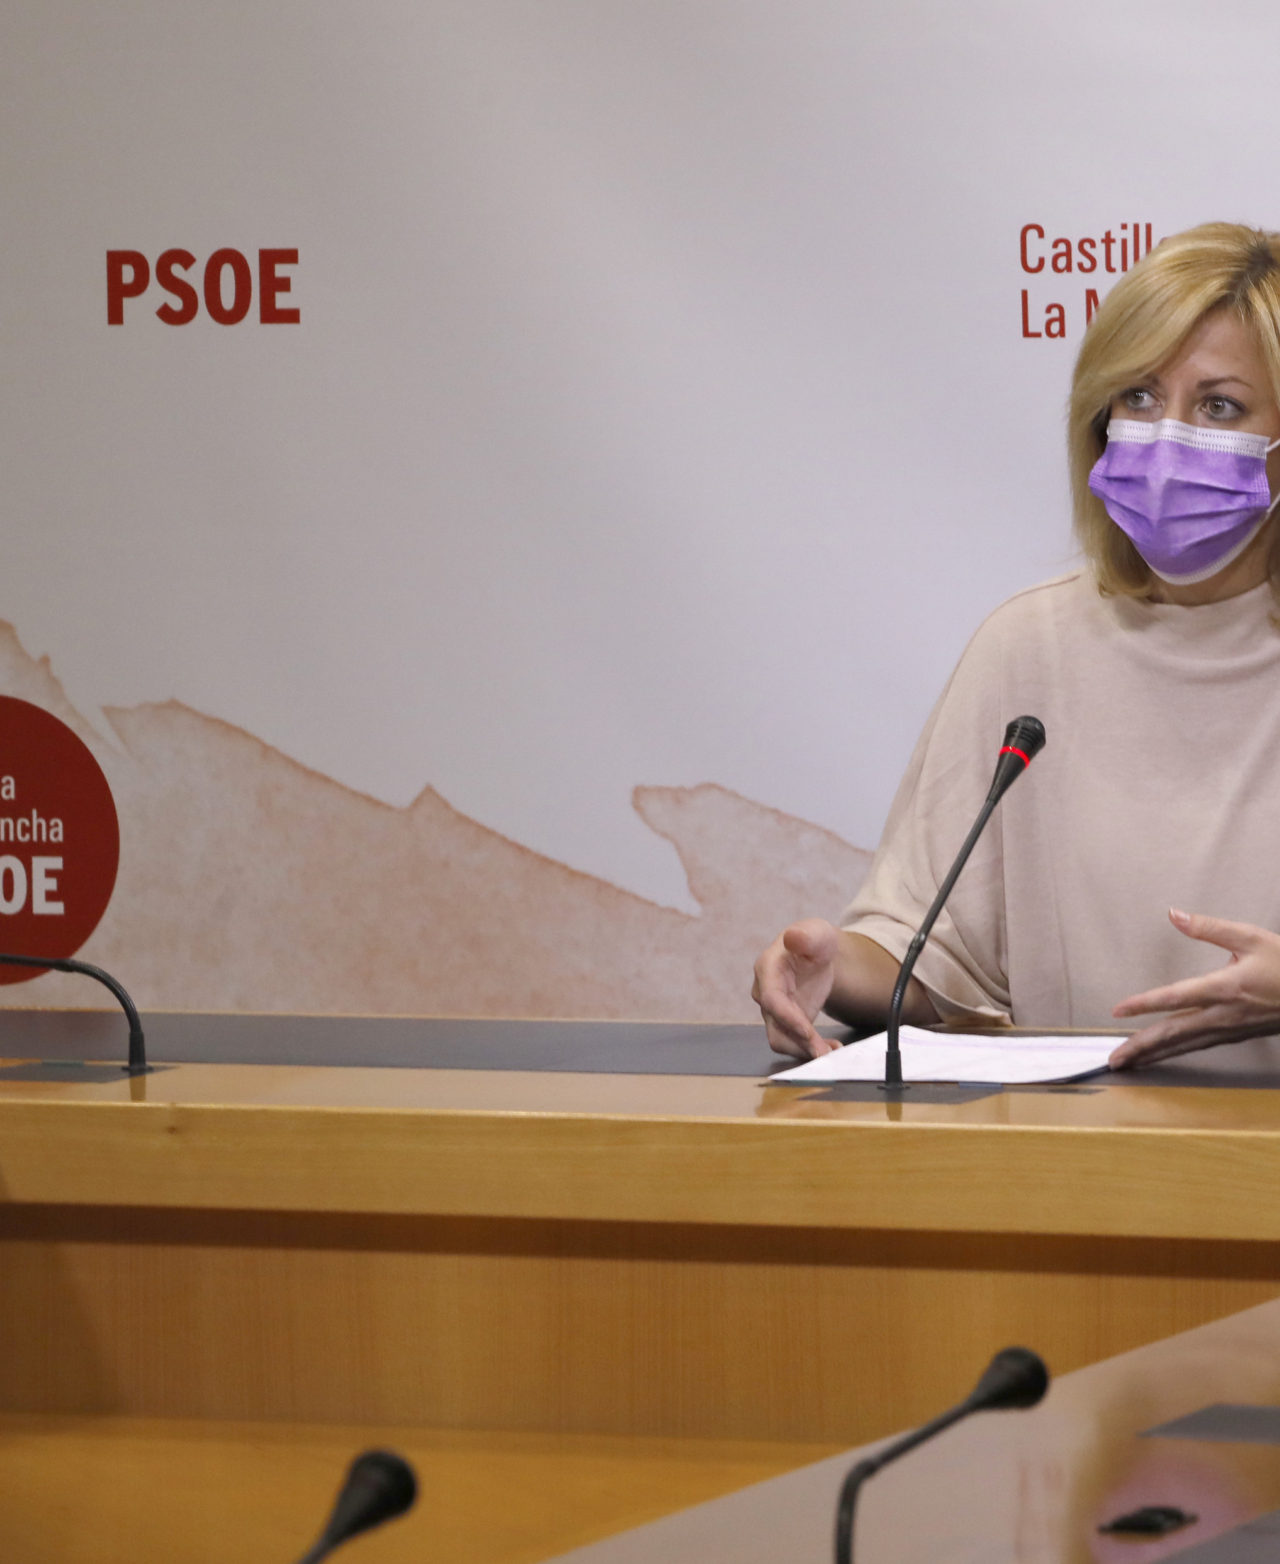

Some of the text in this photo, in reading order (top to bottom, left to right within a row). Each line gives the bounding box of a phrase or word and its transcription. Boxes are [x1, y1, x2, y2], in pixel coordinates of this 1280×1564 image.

[1019, 223, 1167, 274] Castill
[106, 247, 302, 327] PSOE
[1020, 288, 1067, 339] La
